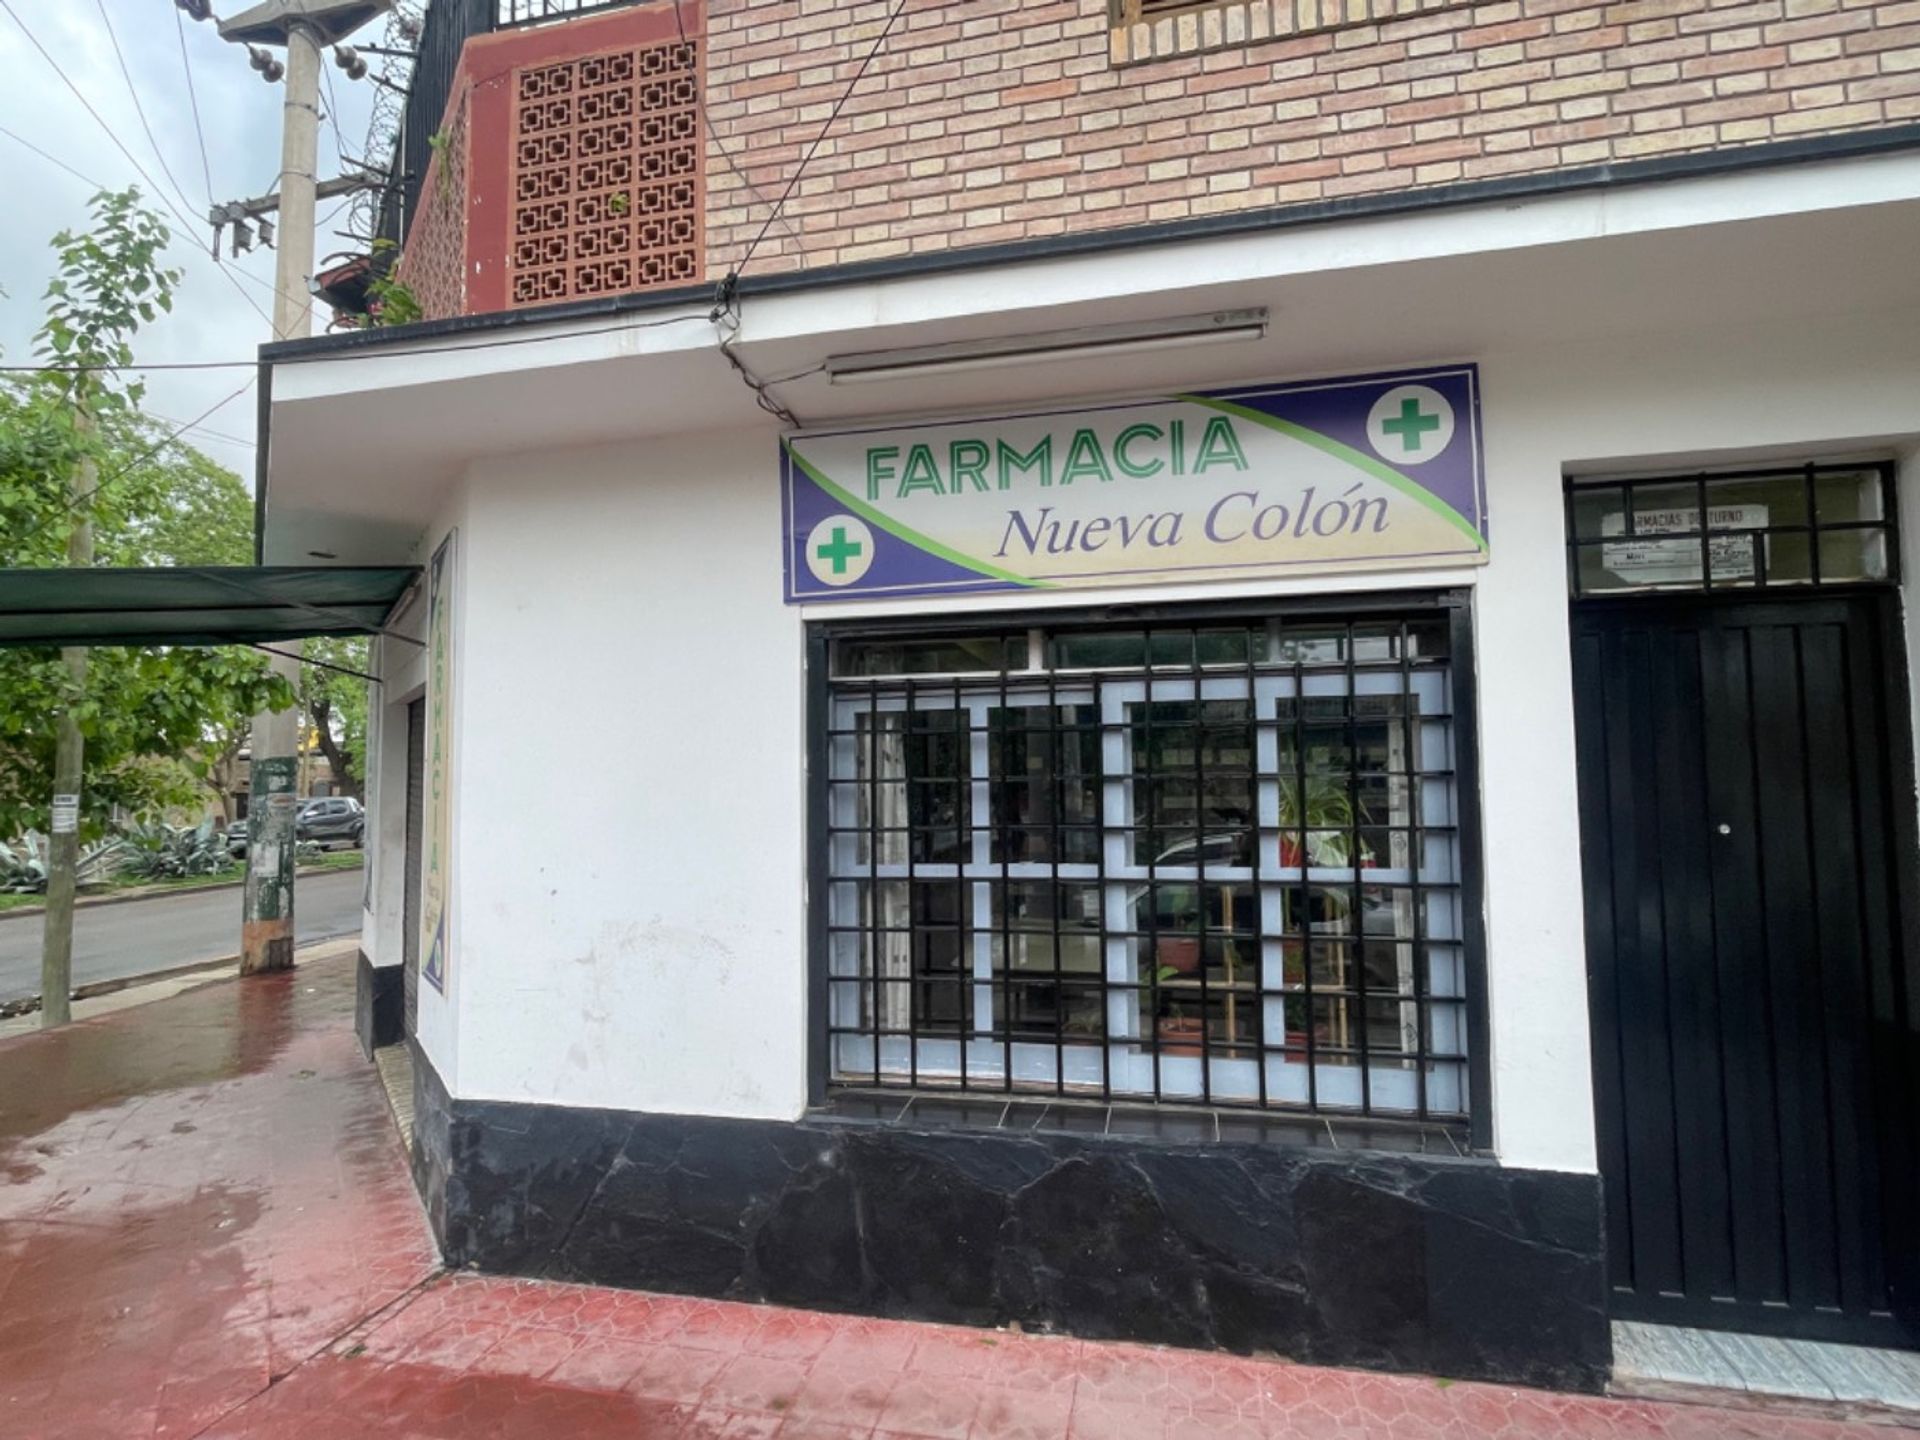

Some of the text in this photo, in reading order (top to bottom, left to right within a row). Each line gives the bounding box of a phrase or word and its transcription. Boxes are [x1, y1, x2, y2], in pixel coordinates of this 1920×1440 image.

[866, 416, 1248, 501] FARMACIA
[993, 483, 1391, 559] Nueva Colón
[430, 596, 445, 875] FARMACIA
